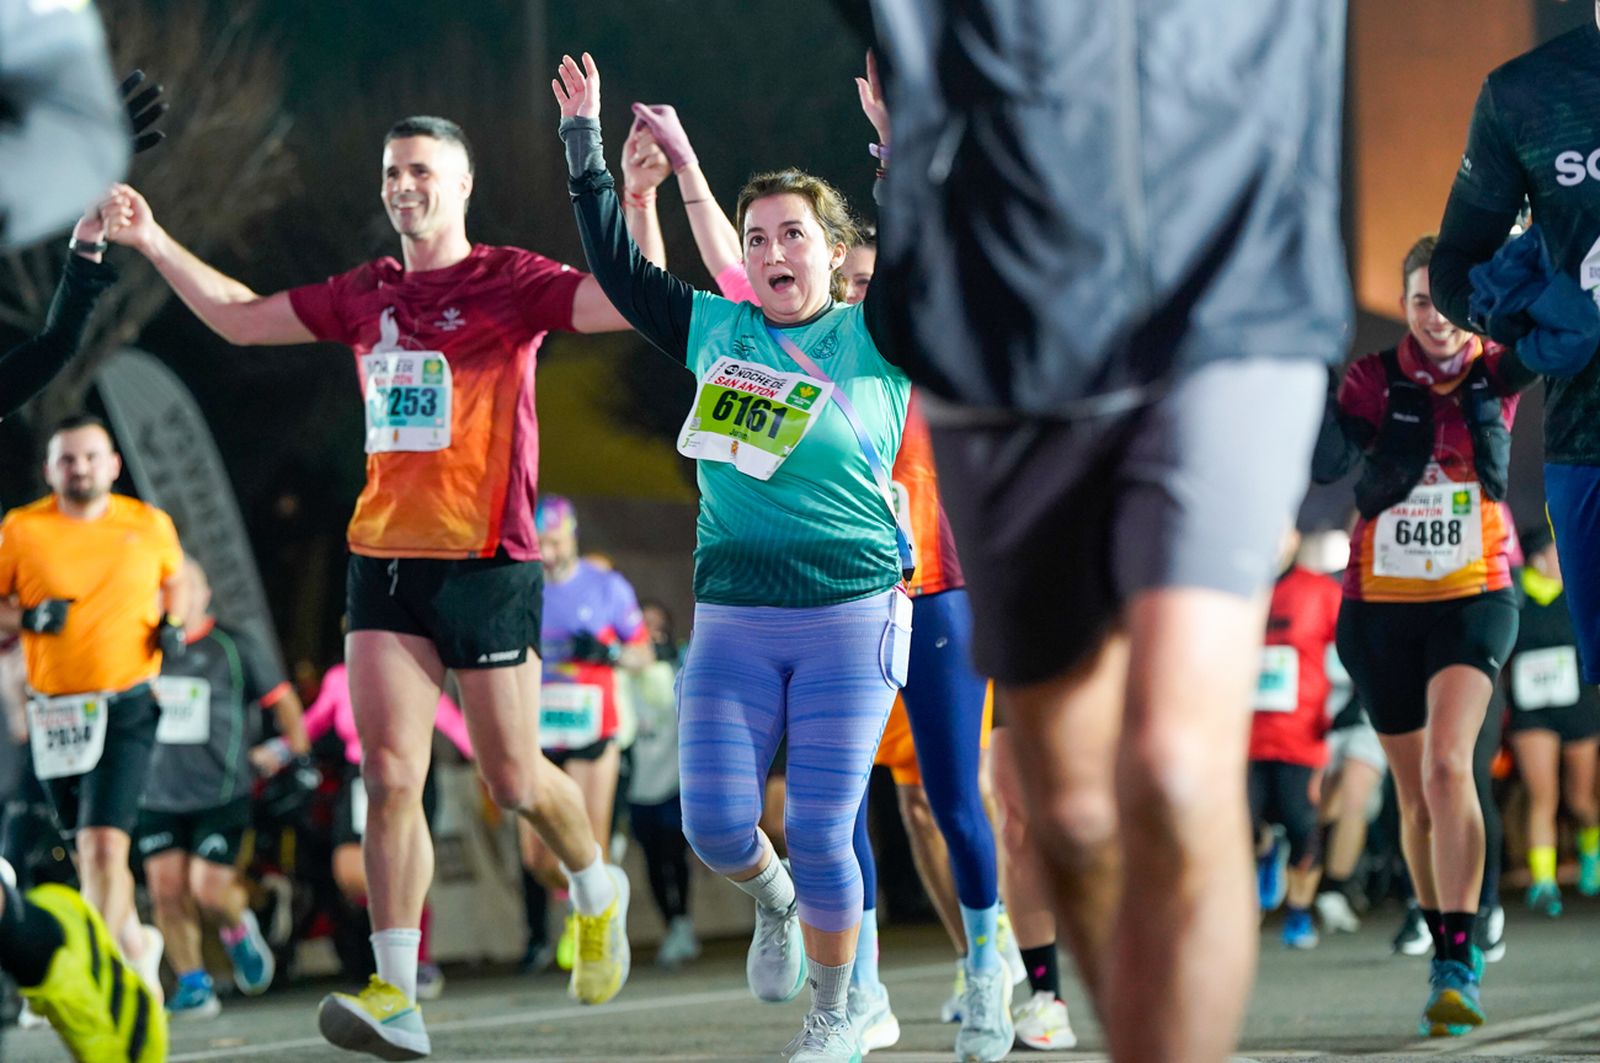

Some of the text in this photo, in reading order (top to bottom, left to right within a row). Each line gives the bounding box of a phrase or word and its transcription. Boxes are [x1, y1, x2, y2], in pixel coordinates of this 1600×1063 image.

[714, 376, 779, 398] SAN ANTON
[735, 368, 771, 386] NOCHE
[771, 378, 788, 390] DE
[712, 390, 788, 440] 6161
[1391, 507, 1443, 517] SAN ANTON
[1395, 519, 1462, 546] 6488
